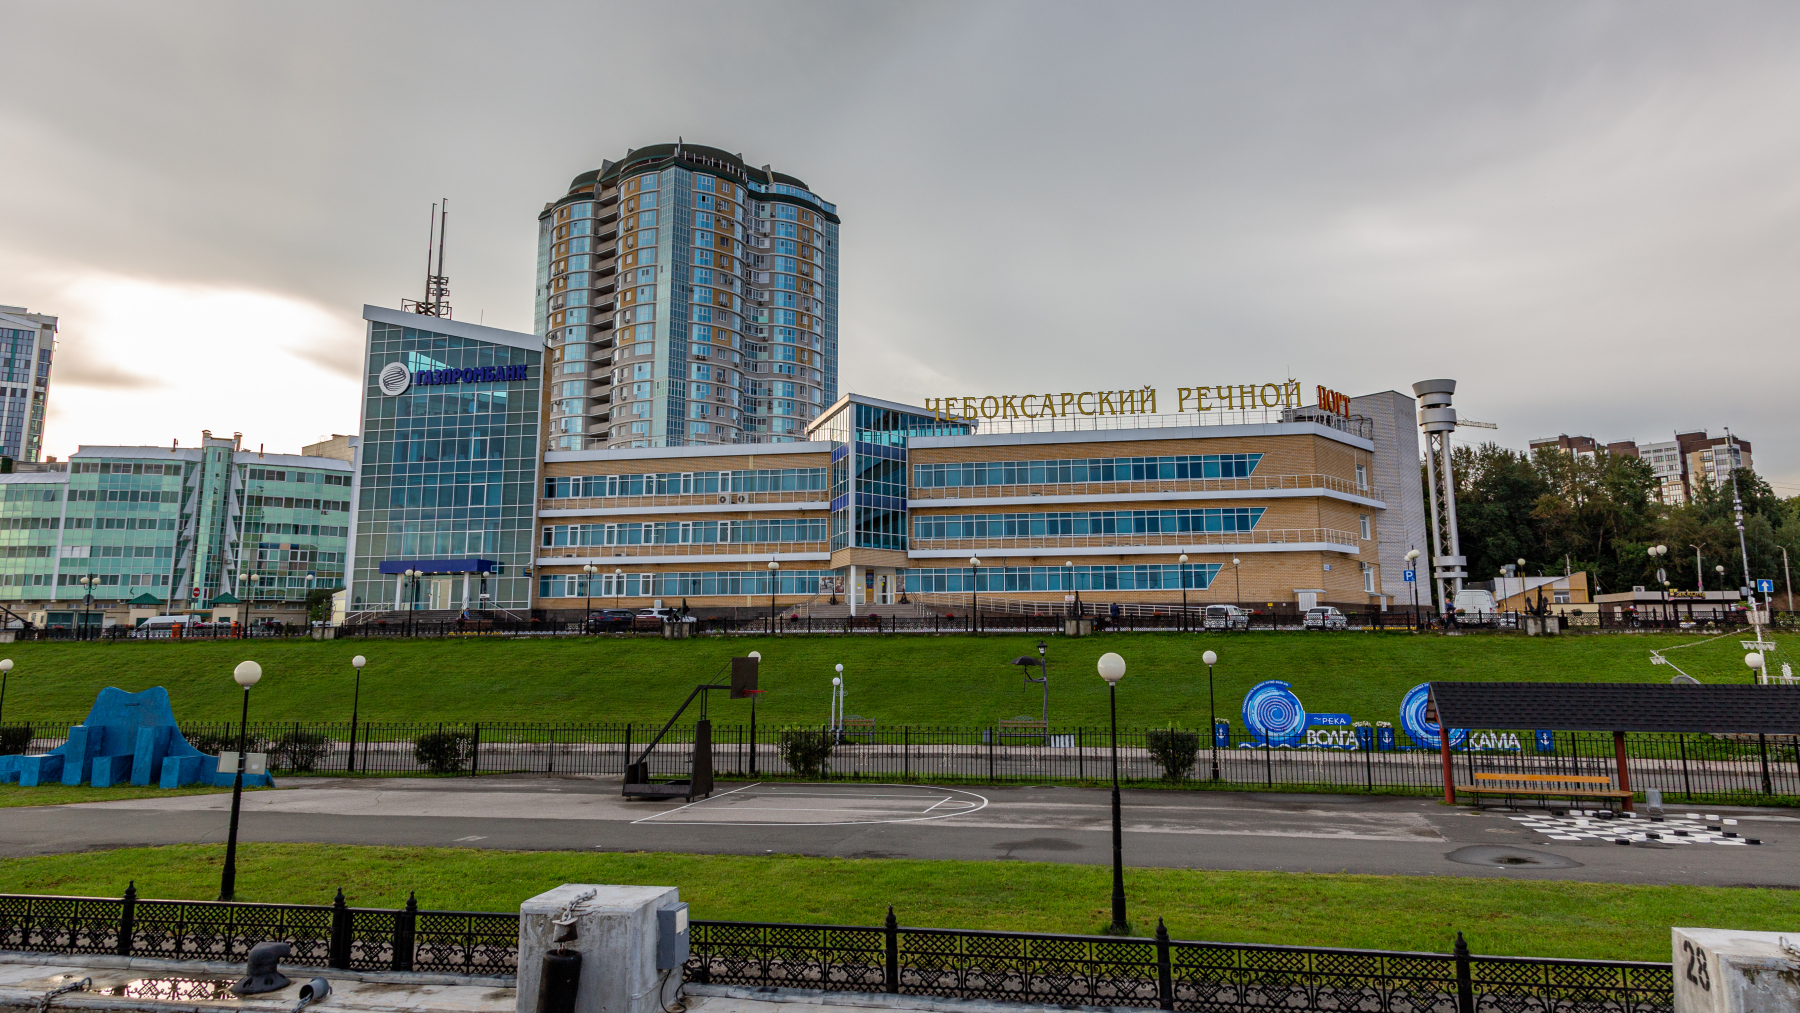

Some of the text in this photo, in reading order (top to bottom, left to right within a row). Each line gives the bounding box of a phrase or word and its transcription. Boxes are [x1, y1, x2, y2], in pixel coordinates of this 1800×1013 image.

[416, 365, 527, 386] ГАЗПРОМБАНК
[925, 378, 1351, 421] ЧЕБОКСАРСКИЙ РЕЧНОЙ ПОРТ
[1322, 717, 1347, 725] РЕКА
[1306, 729, 1360, 750] ВОЛГА
[1469, 732, 1521, 749] КАМА
